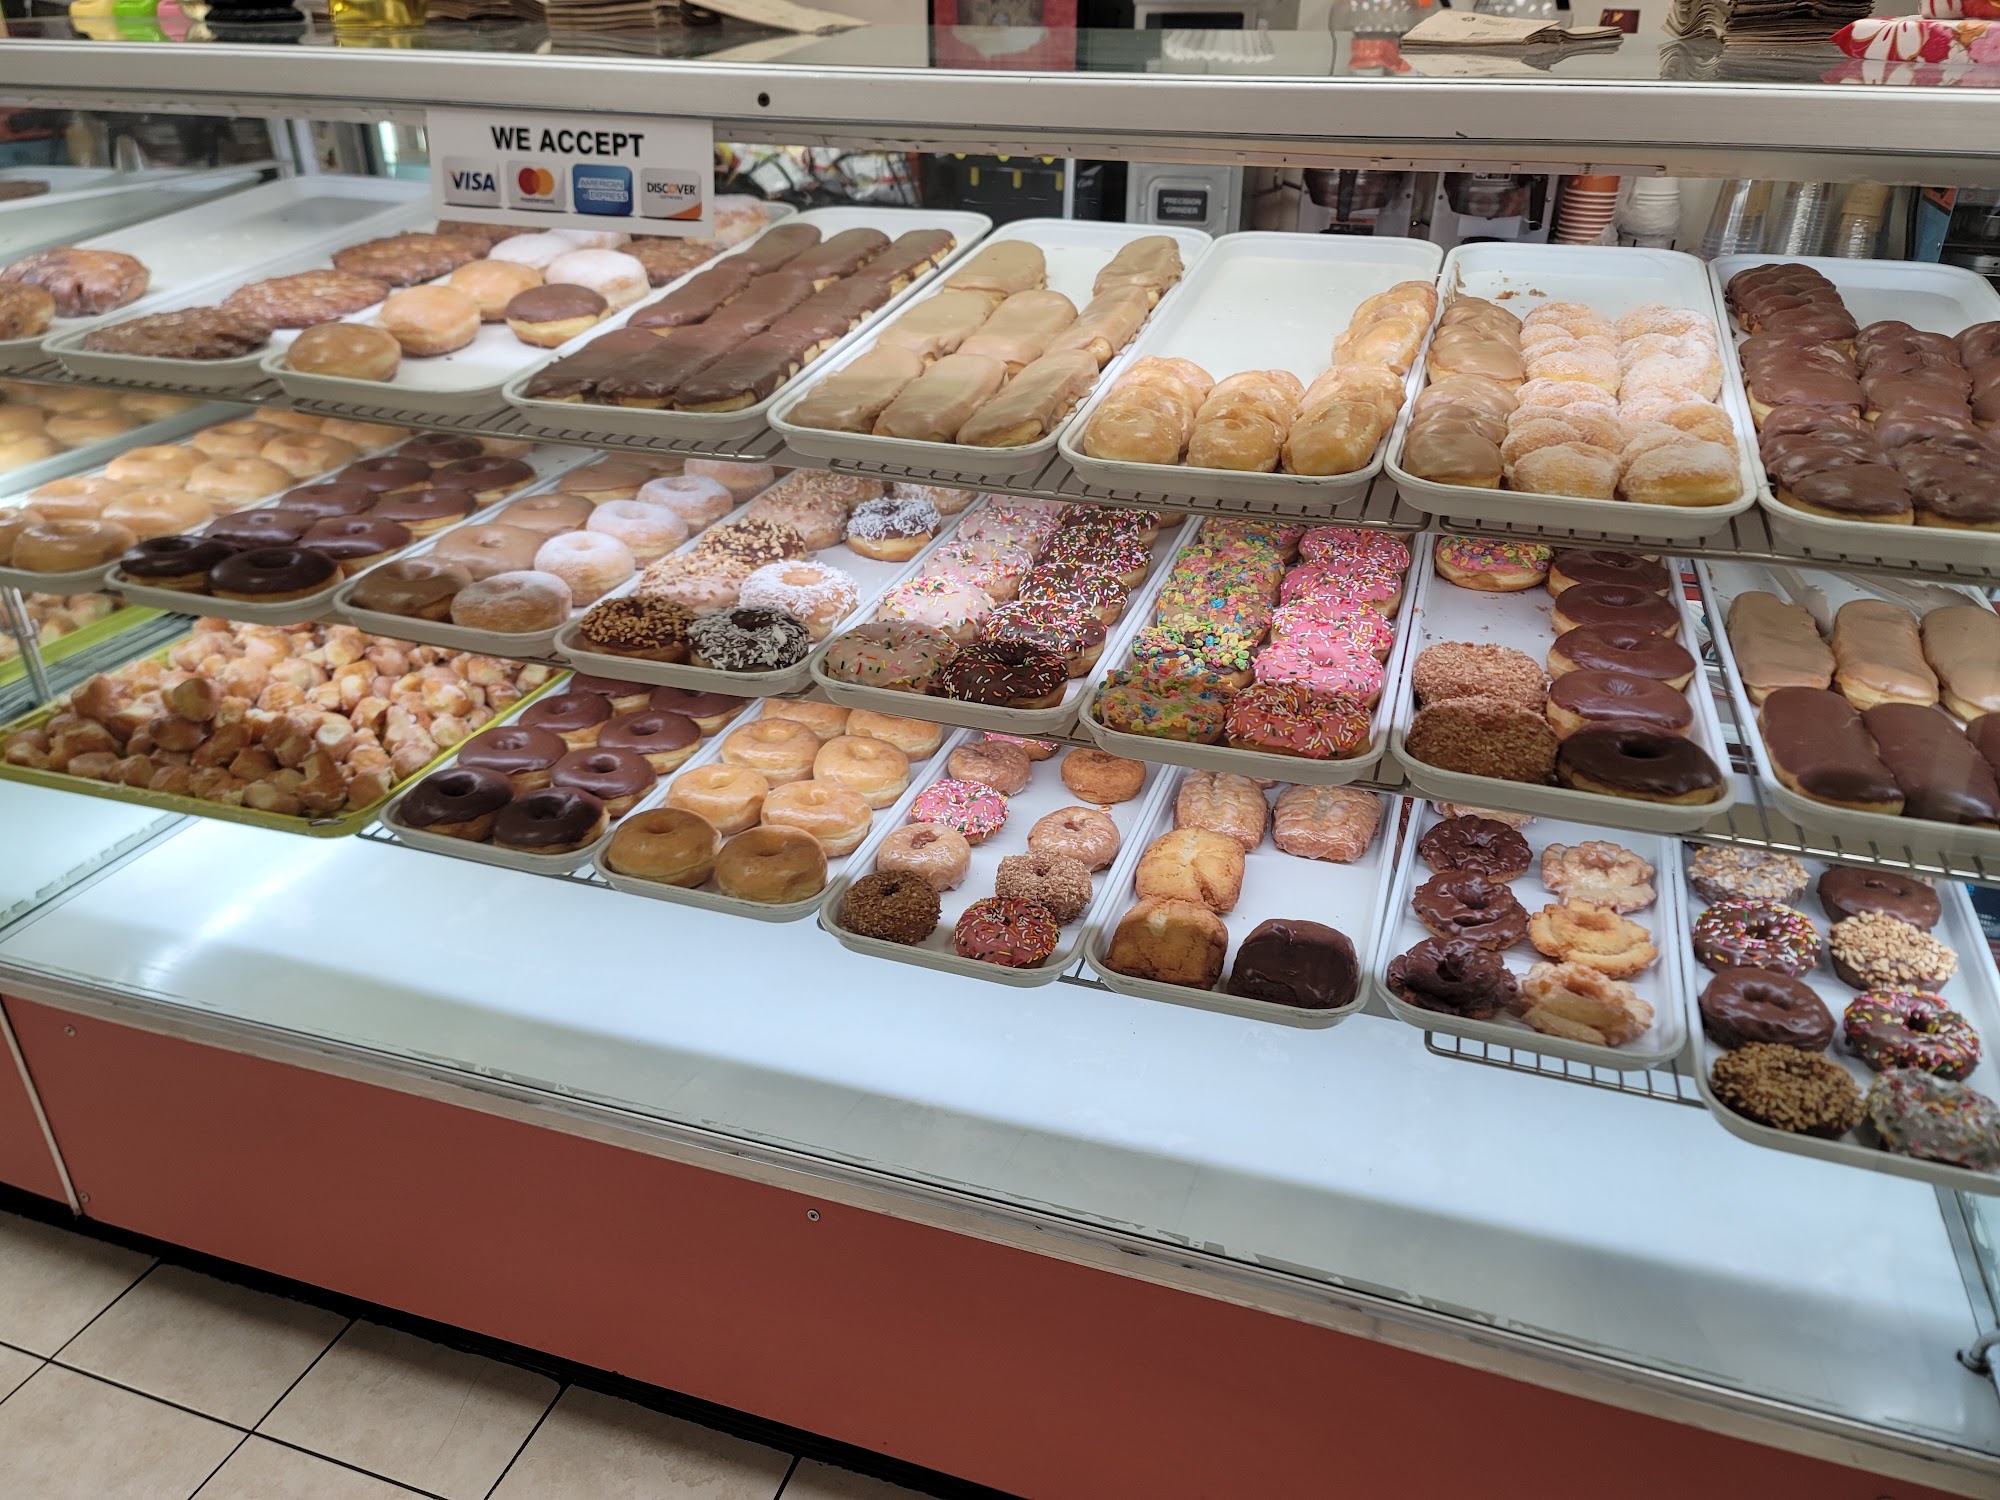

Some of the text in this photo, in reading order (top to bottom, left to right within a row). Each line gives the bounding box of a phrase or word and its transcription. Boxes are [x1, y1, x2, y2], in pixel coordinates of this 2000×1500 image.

[491, 126, 645, 158] WE ACCEPT
[449, 171, 496, 192] VISA
[579, 178, 625, 190] AMERICAN
[589, 190, 629, 202] EXPRESS
[646, 182, 697, 196] DISCOVER
